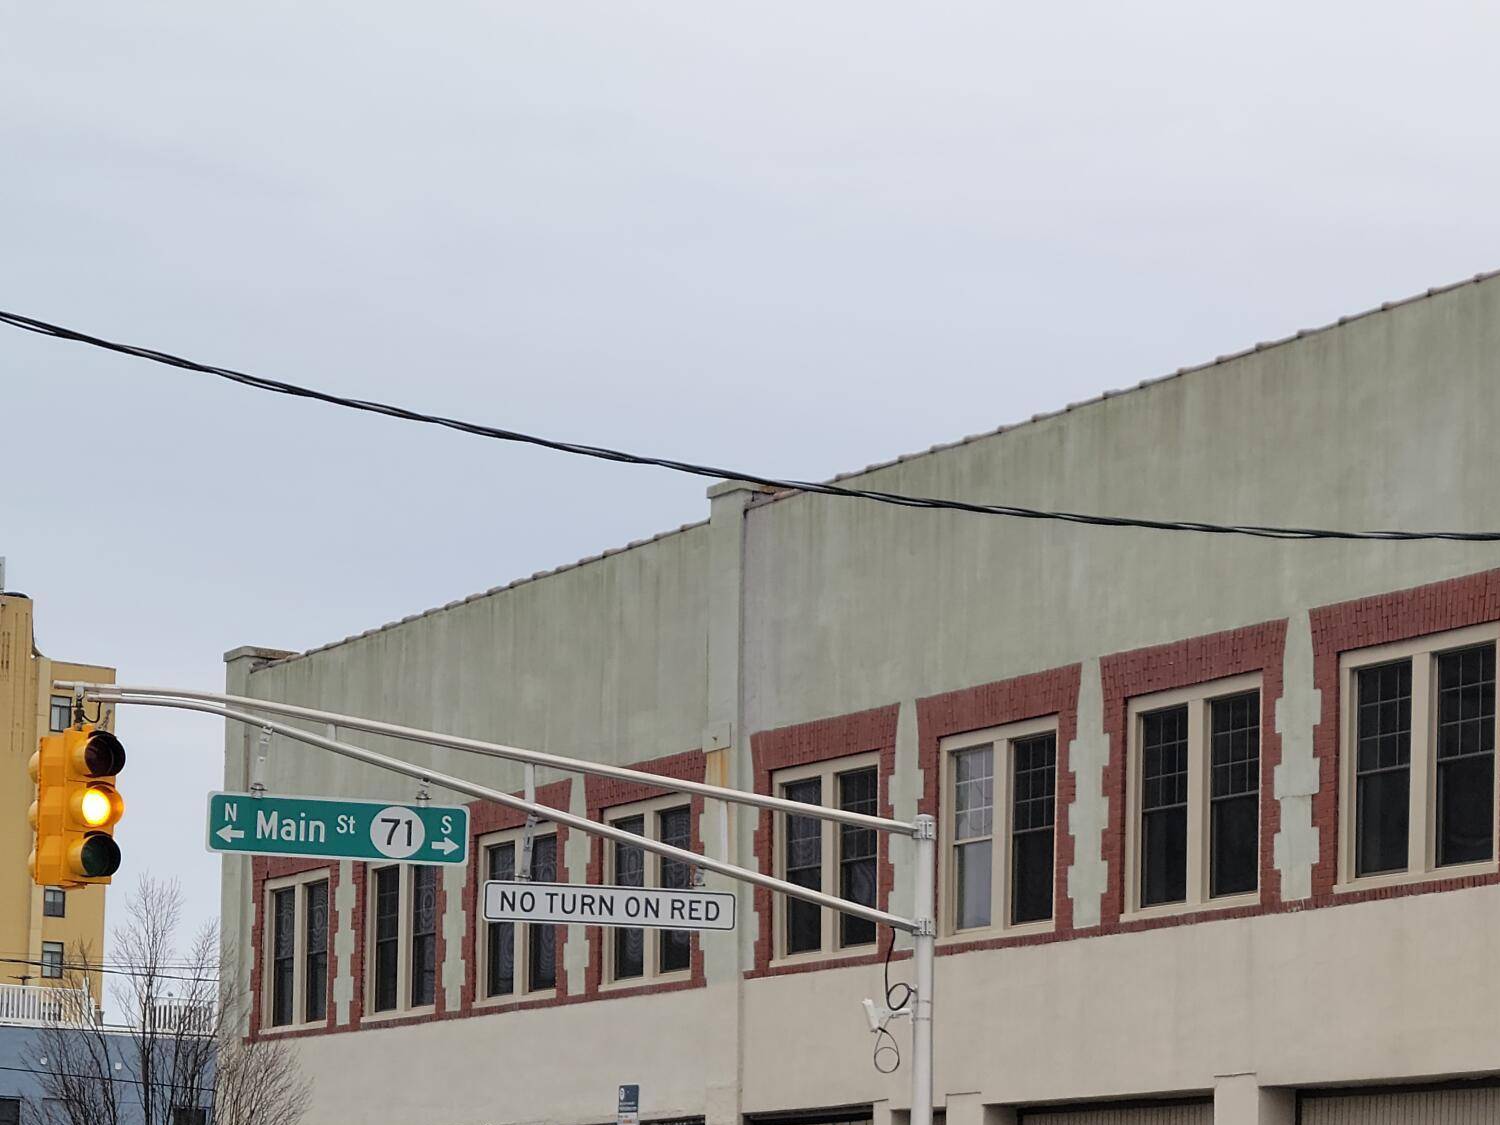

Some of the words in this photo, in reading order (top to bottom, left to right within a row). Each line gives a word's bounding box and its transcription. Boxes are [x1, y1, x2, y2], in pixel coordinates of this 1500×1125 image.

[224, 803, 237, 821] N
[255, 810, 326, 843] Main
[336, 814, 356, 834] St
[380, 817, 414, 846] 71
[441, 816, 452, 834] S
[500, 890, 535, 914] NO
[546, 891, 613, 916] TURN
[625, 896, 662, 918] ON
[671, 899, 719, 922] RED
